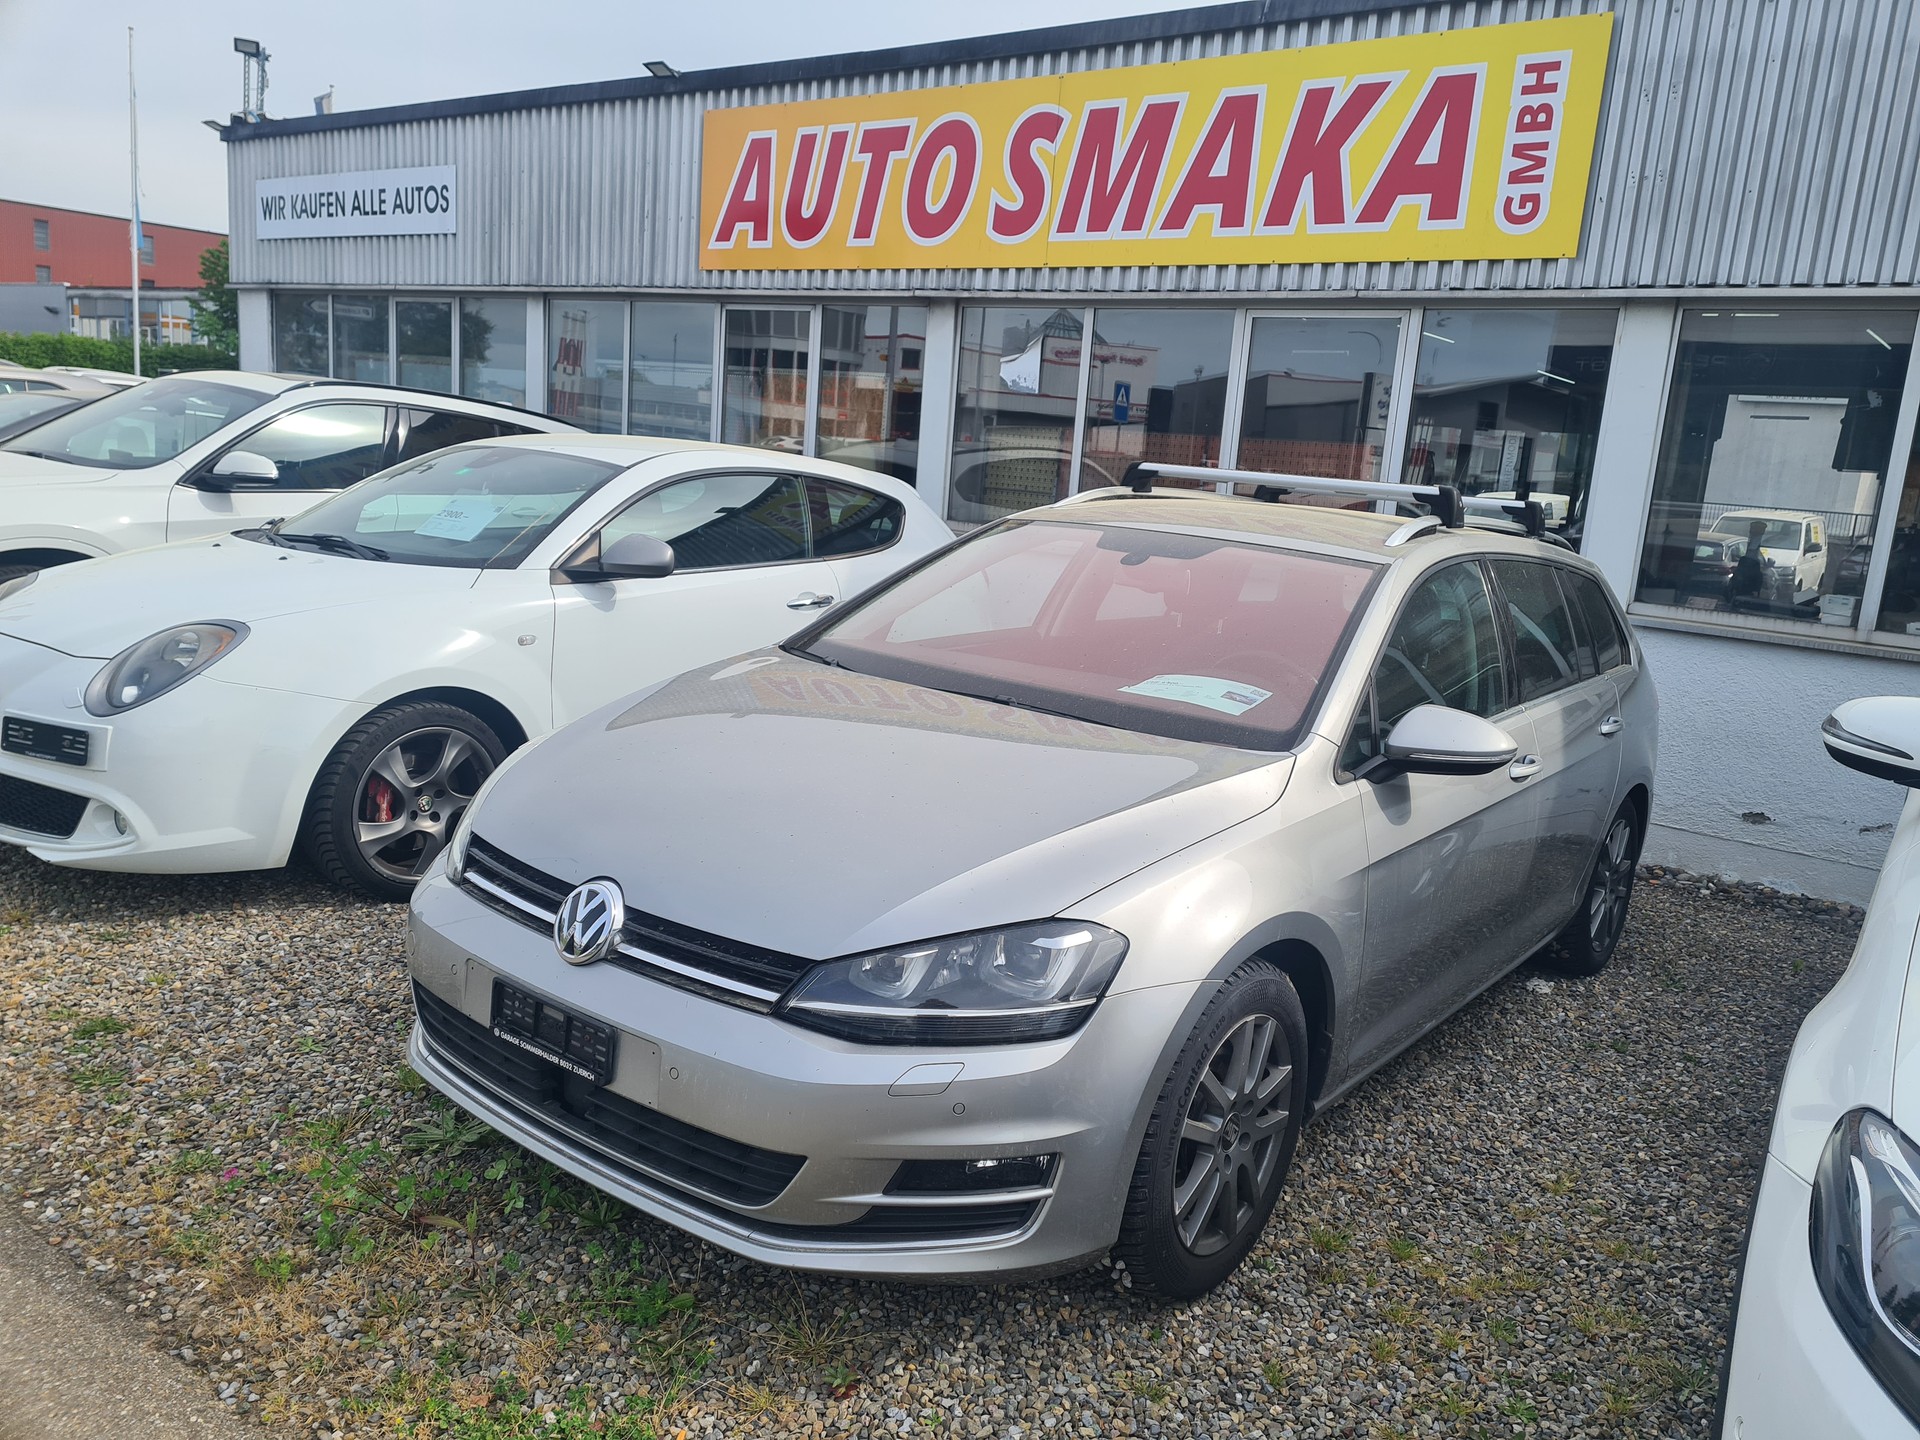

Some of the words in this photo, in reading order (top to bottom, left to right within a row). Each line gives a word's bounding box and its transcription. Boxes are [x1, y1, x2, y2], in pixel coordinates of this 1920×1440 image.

[709, 112, 982, 249] AUTO
[988, 63, 1486, 243] SMAKA
[1499, 53, 1570, 231] GMBH
[261, 195, 286, 221] WIR
[291, 190, 346, 220] KAUFEN
[351, 188, 387, 217] ALLE
[392, 184, 450, 215] AUTOS
[500, 1031, 520, 1046] GARAGE
[519, 1040, 560, 1065] SOMMERHALDER
[560, 1059, 573, 1071] 8032
[573, 1065, 595, 1081] ZUERICH
